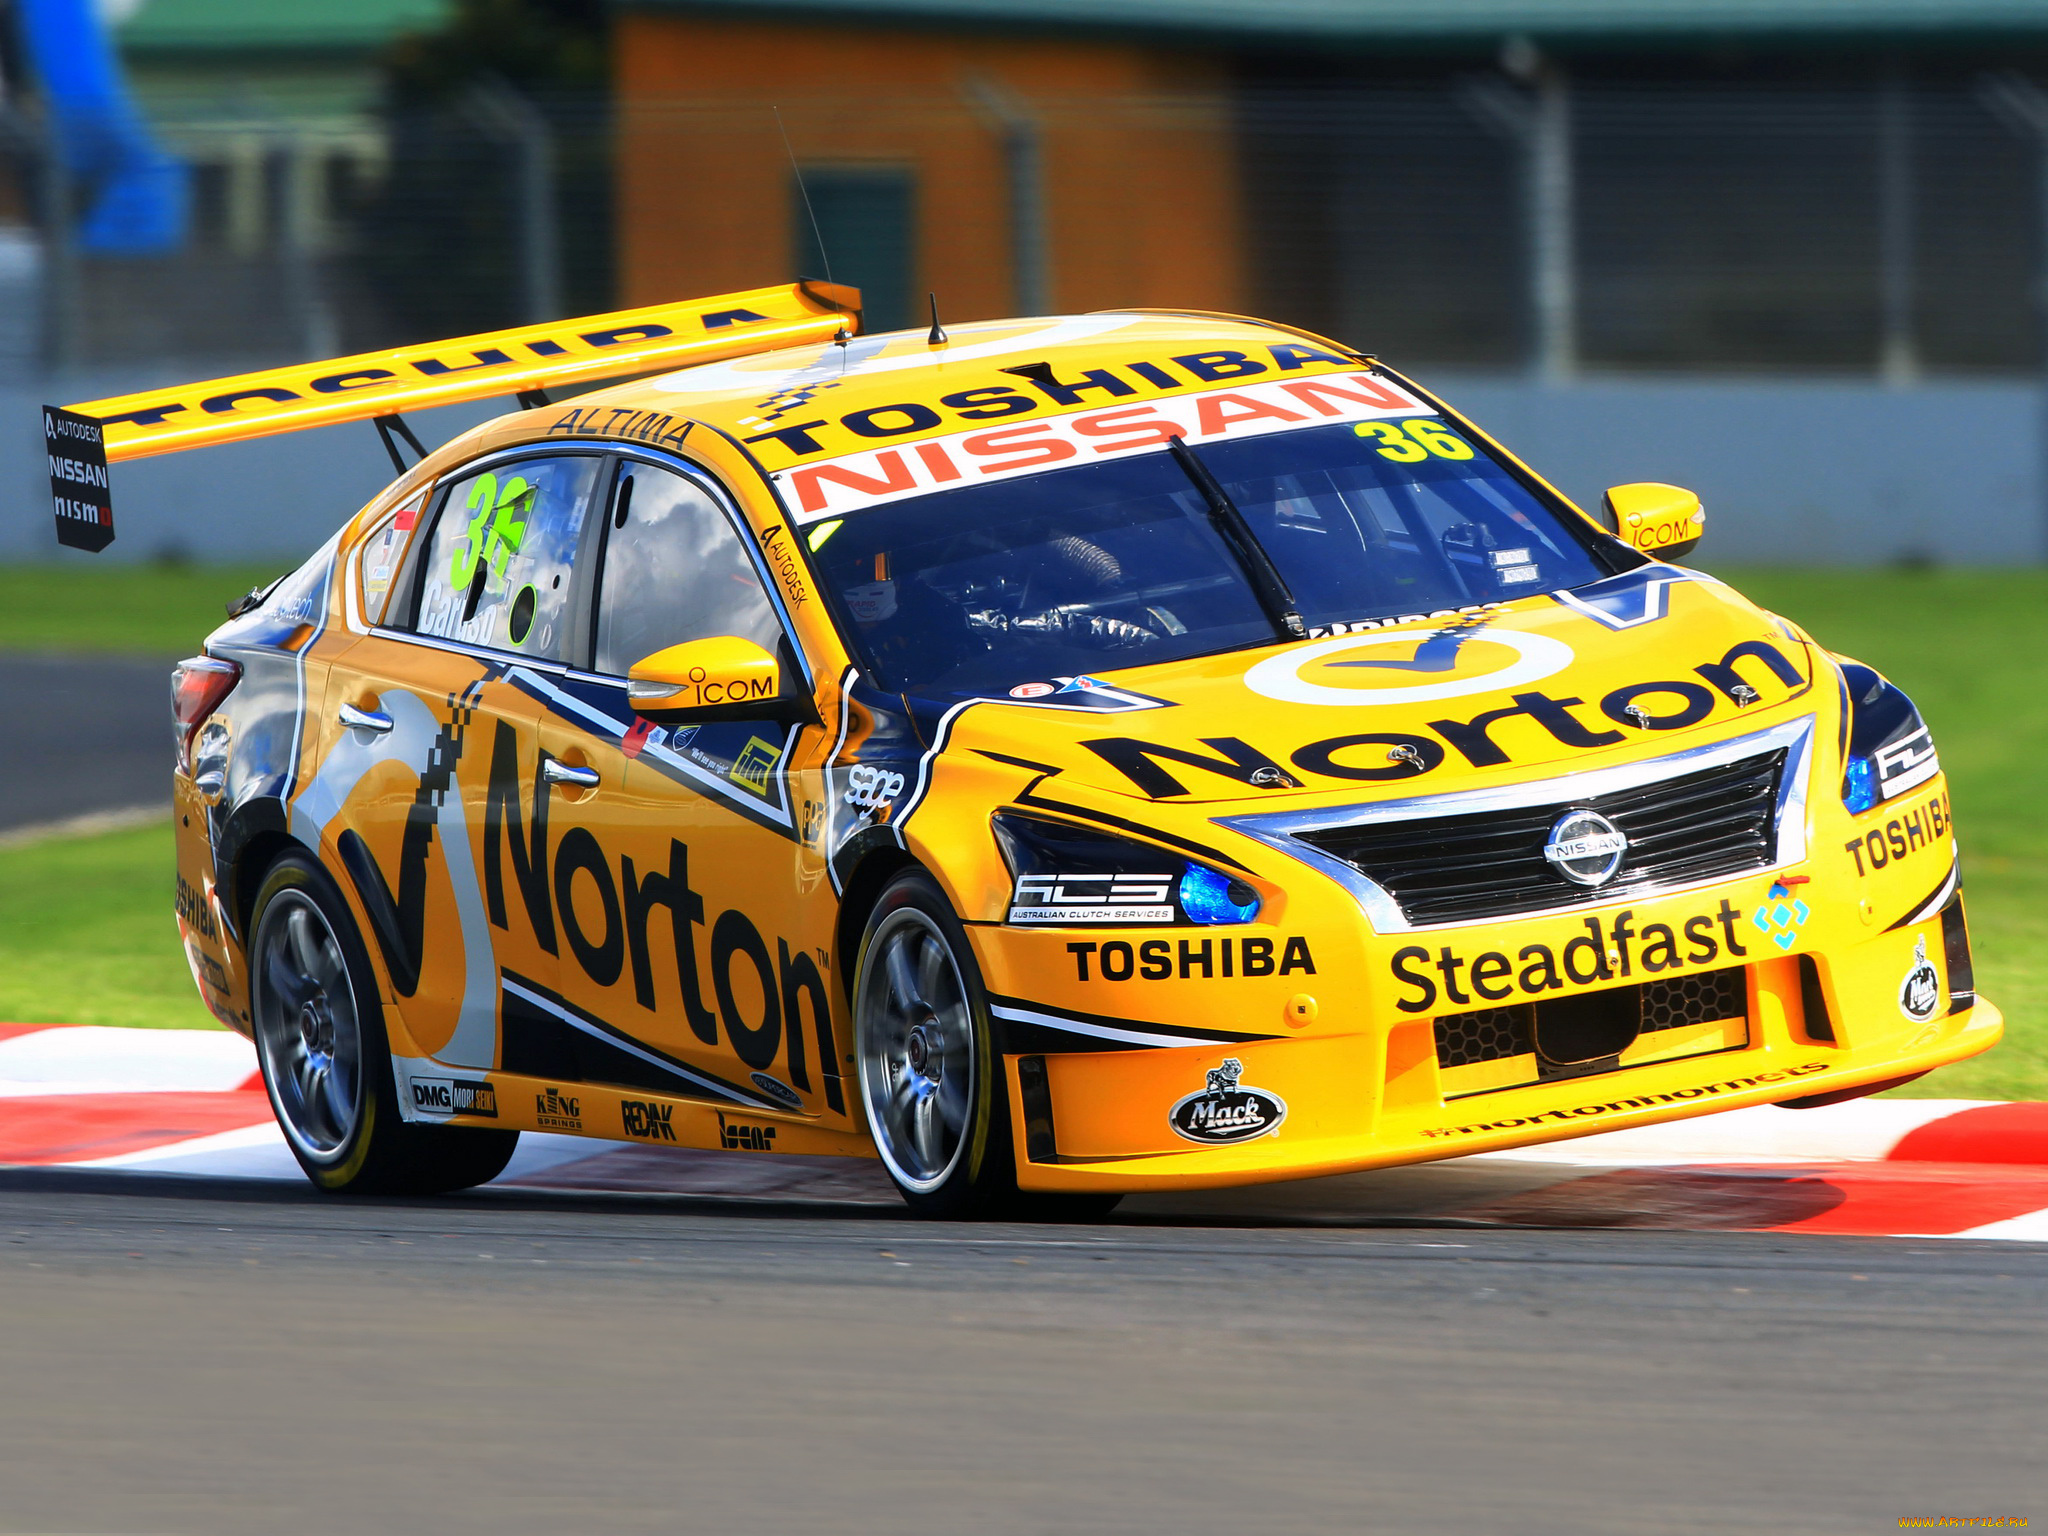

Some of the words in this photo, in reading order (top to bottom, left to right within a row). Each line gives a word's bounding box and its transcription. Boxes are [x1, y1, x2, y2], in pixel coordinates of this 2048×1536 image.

[742, 342, 1353, 456] TOSHIBA
[57, 418, 102, 443] AUTODESK
[546, 407, 696, 451] ALTIMA
[790, 376, 1417, 513] NISSAN
[1354, 418, 1475, 463] 36
[48, 454, 108, 489] NISSAN
[54, 495, 112, 527] nismo
[770, 541, 808, 610] AUTODESK
[1075, 640, 1807, 799] Norton
[844, 764, 905, 820] sage
[1556, 838, 1620, 857] NISSAN
[1846, 792, 1952, 877] TOSHIBA
[484, 717, 846, 1118] Norton
[1012, 910, 1067, 919] AUSTRALIAN
[1069, 910, 1112, 919] CLUTCH
[1114, 910, 1169, 919] SERVICES
[1066, 936, 1318, 983] TOSHIBA
[1390, 899, 1748, 1014] Steadfast
[412, 1084, 452, 1108] DMG
[454, 1087, 474, 1109] MORI
[475, 1090, 494, 1111] SEIKI
[536, 1087, 580, 1117] KING
[1188, 1096, 1265, 1132] Mack
[1420, 1061, 1830, 1138] #nortonhornets
[537, 1117, 583, 1129] SPRINGS
